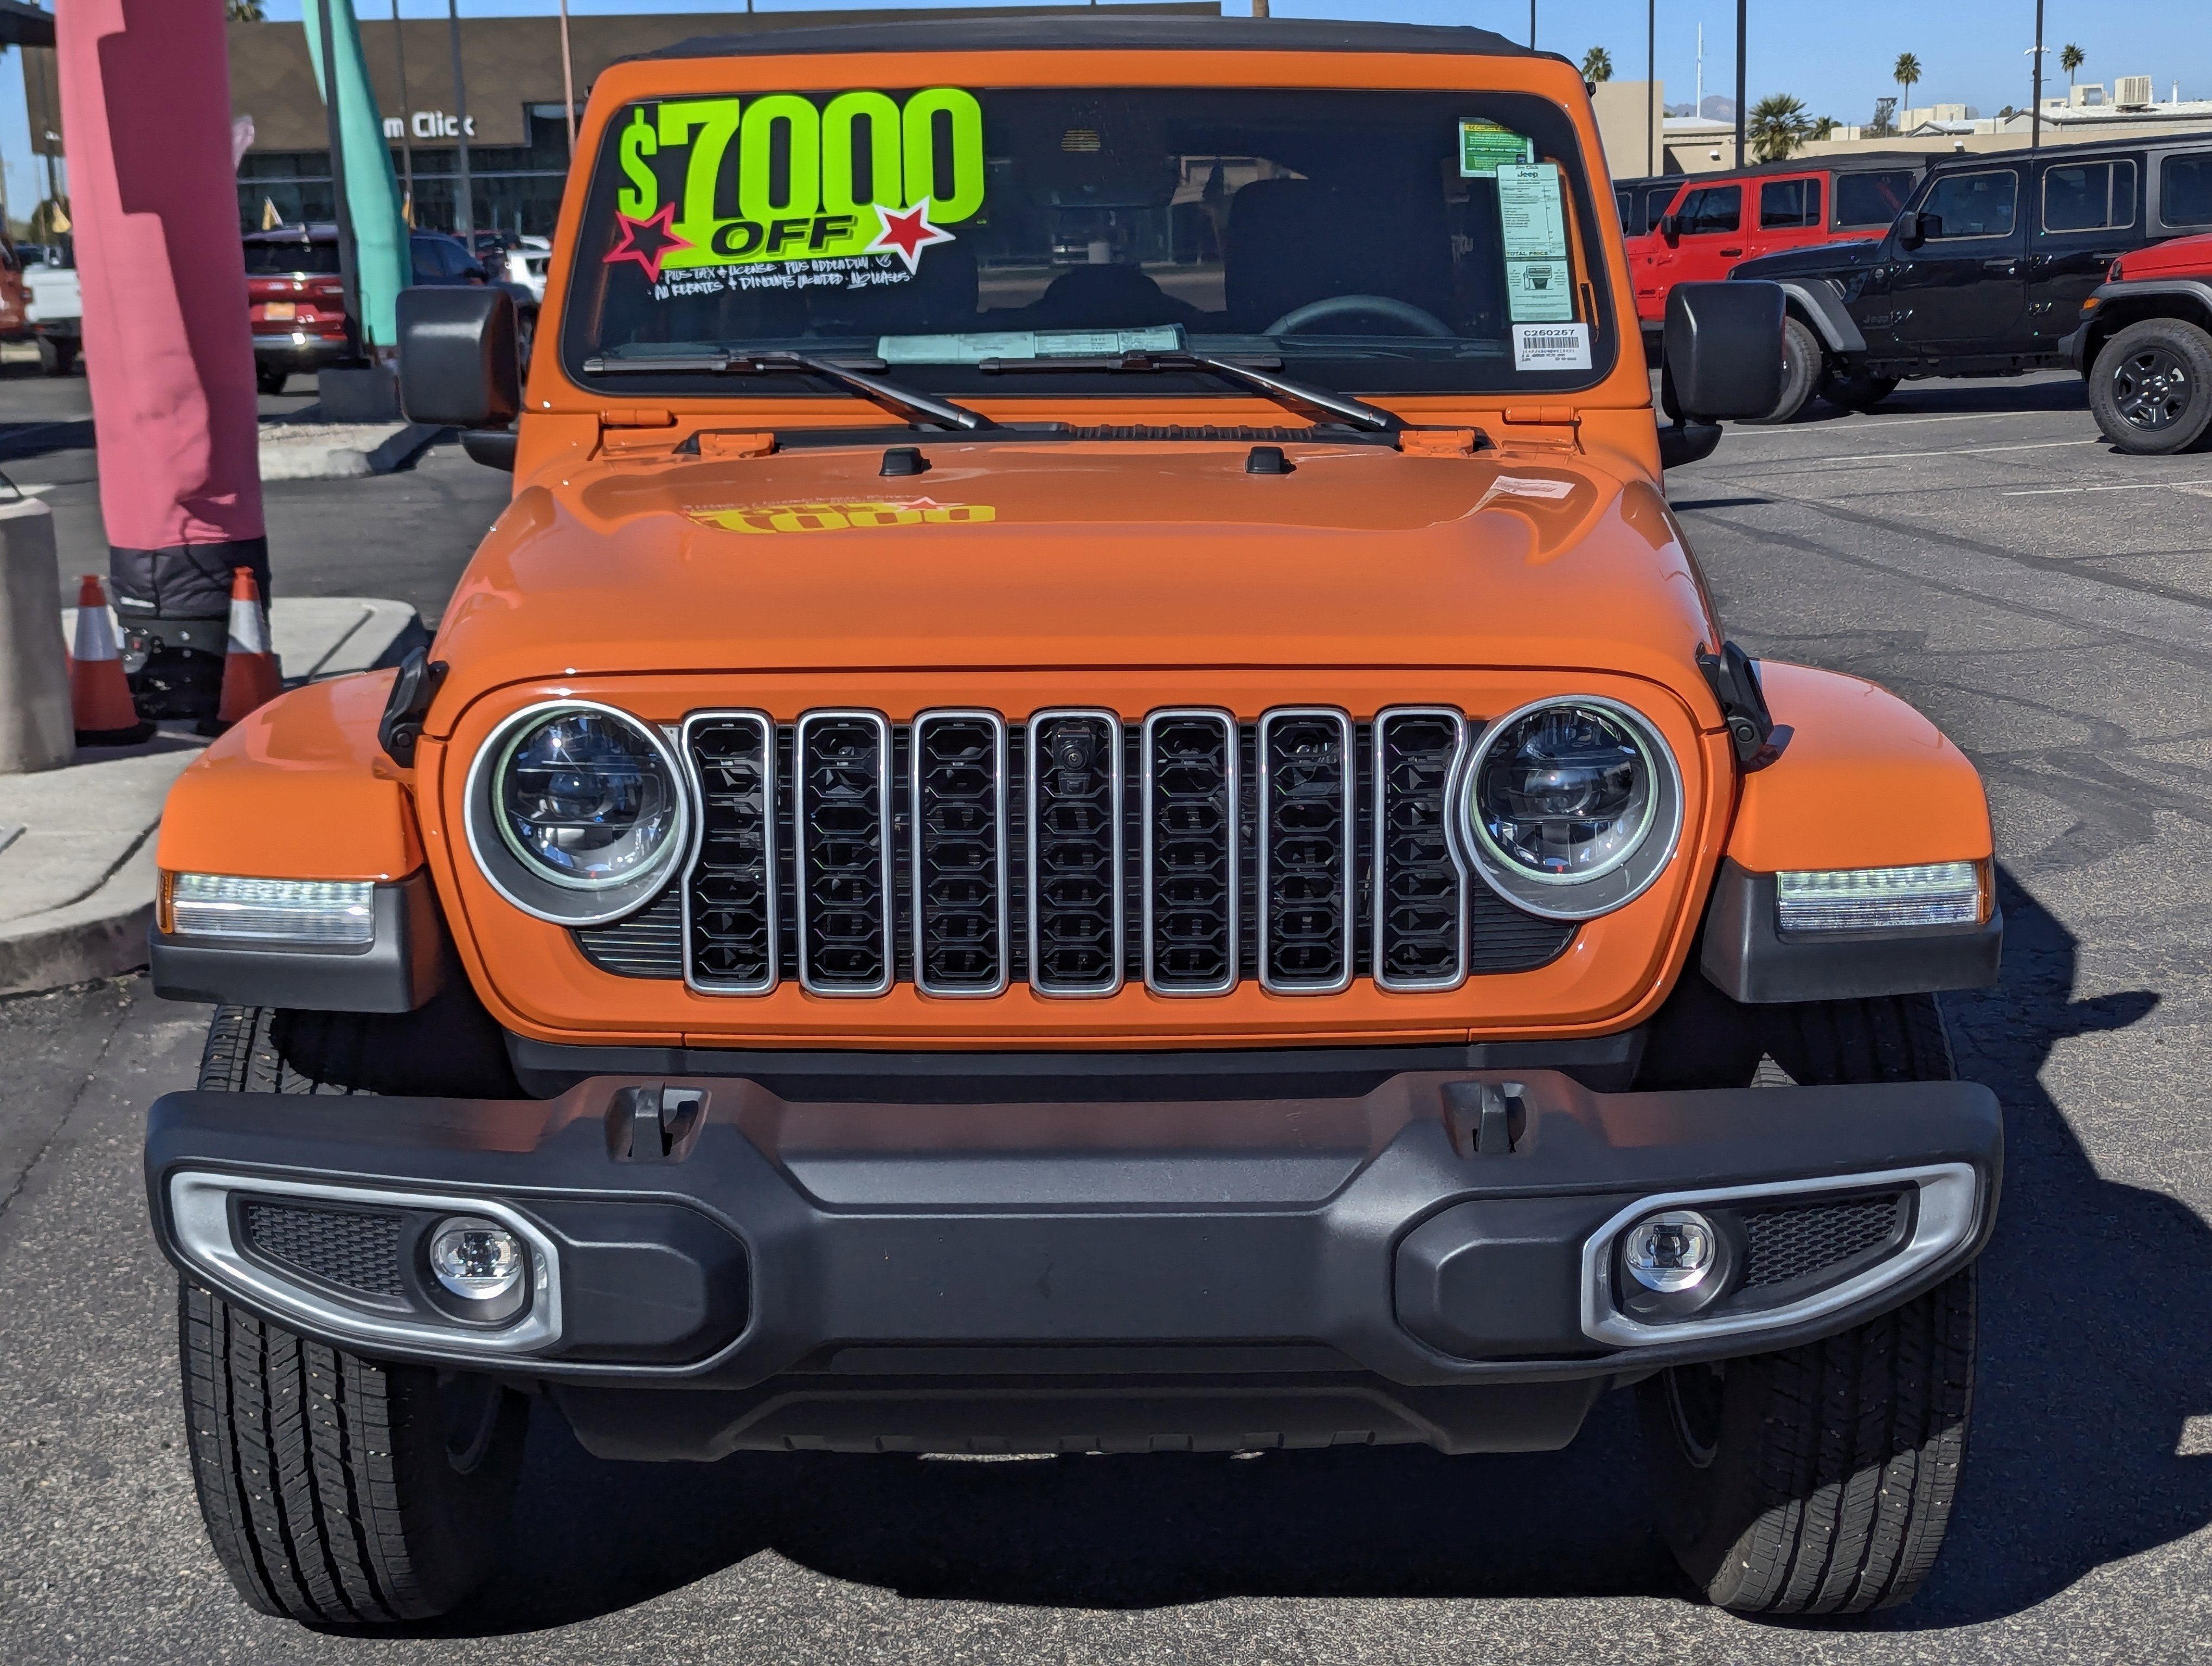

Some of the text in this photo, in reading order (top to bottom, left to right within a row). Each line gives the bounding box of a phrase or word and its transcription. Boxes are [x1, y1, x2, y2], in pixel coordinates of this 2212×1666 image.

[412, 110, 475, 137] Click
[617, 88, 985, 224] $7000
[710, 215, 857, 259] OFF
[690, 266, 715, 279] TAX
[728, 262, 777, 276] LICENSE
[785, 260, 809, 275] PLUS
